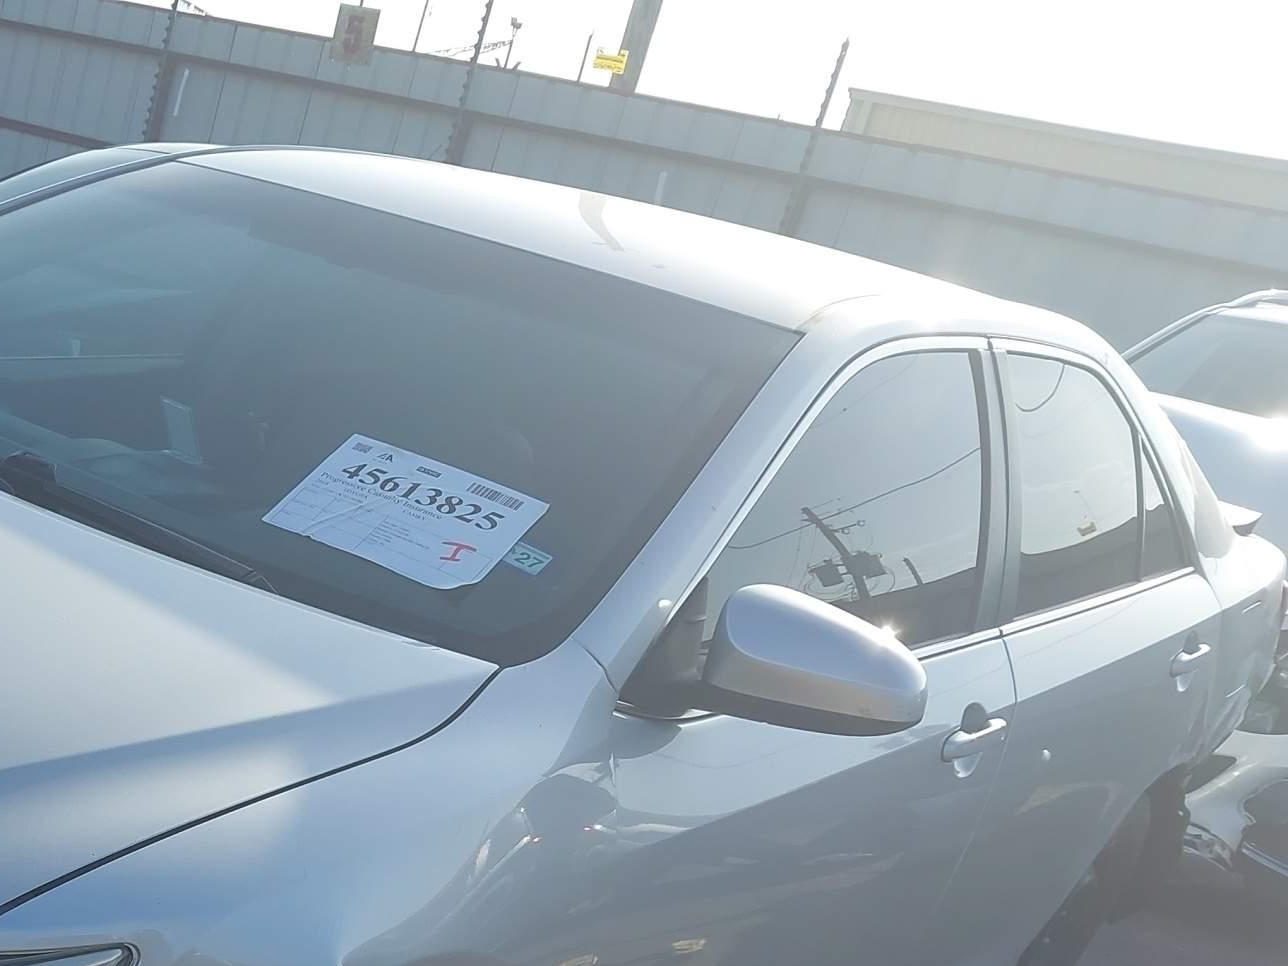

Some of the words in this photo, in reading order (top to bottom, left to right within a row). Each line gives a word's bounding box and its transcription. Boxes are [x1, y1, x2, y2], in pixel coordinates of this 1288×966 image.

[321, 471, 366, 492] Progressive
[402, 499, 443, 520] Insurance
[341, 463, 505, 531] 45613825
